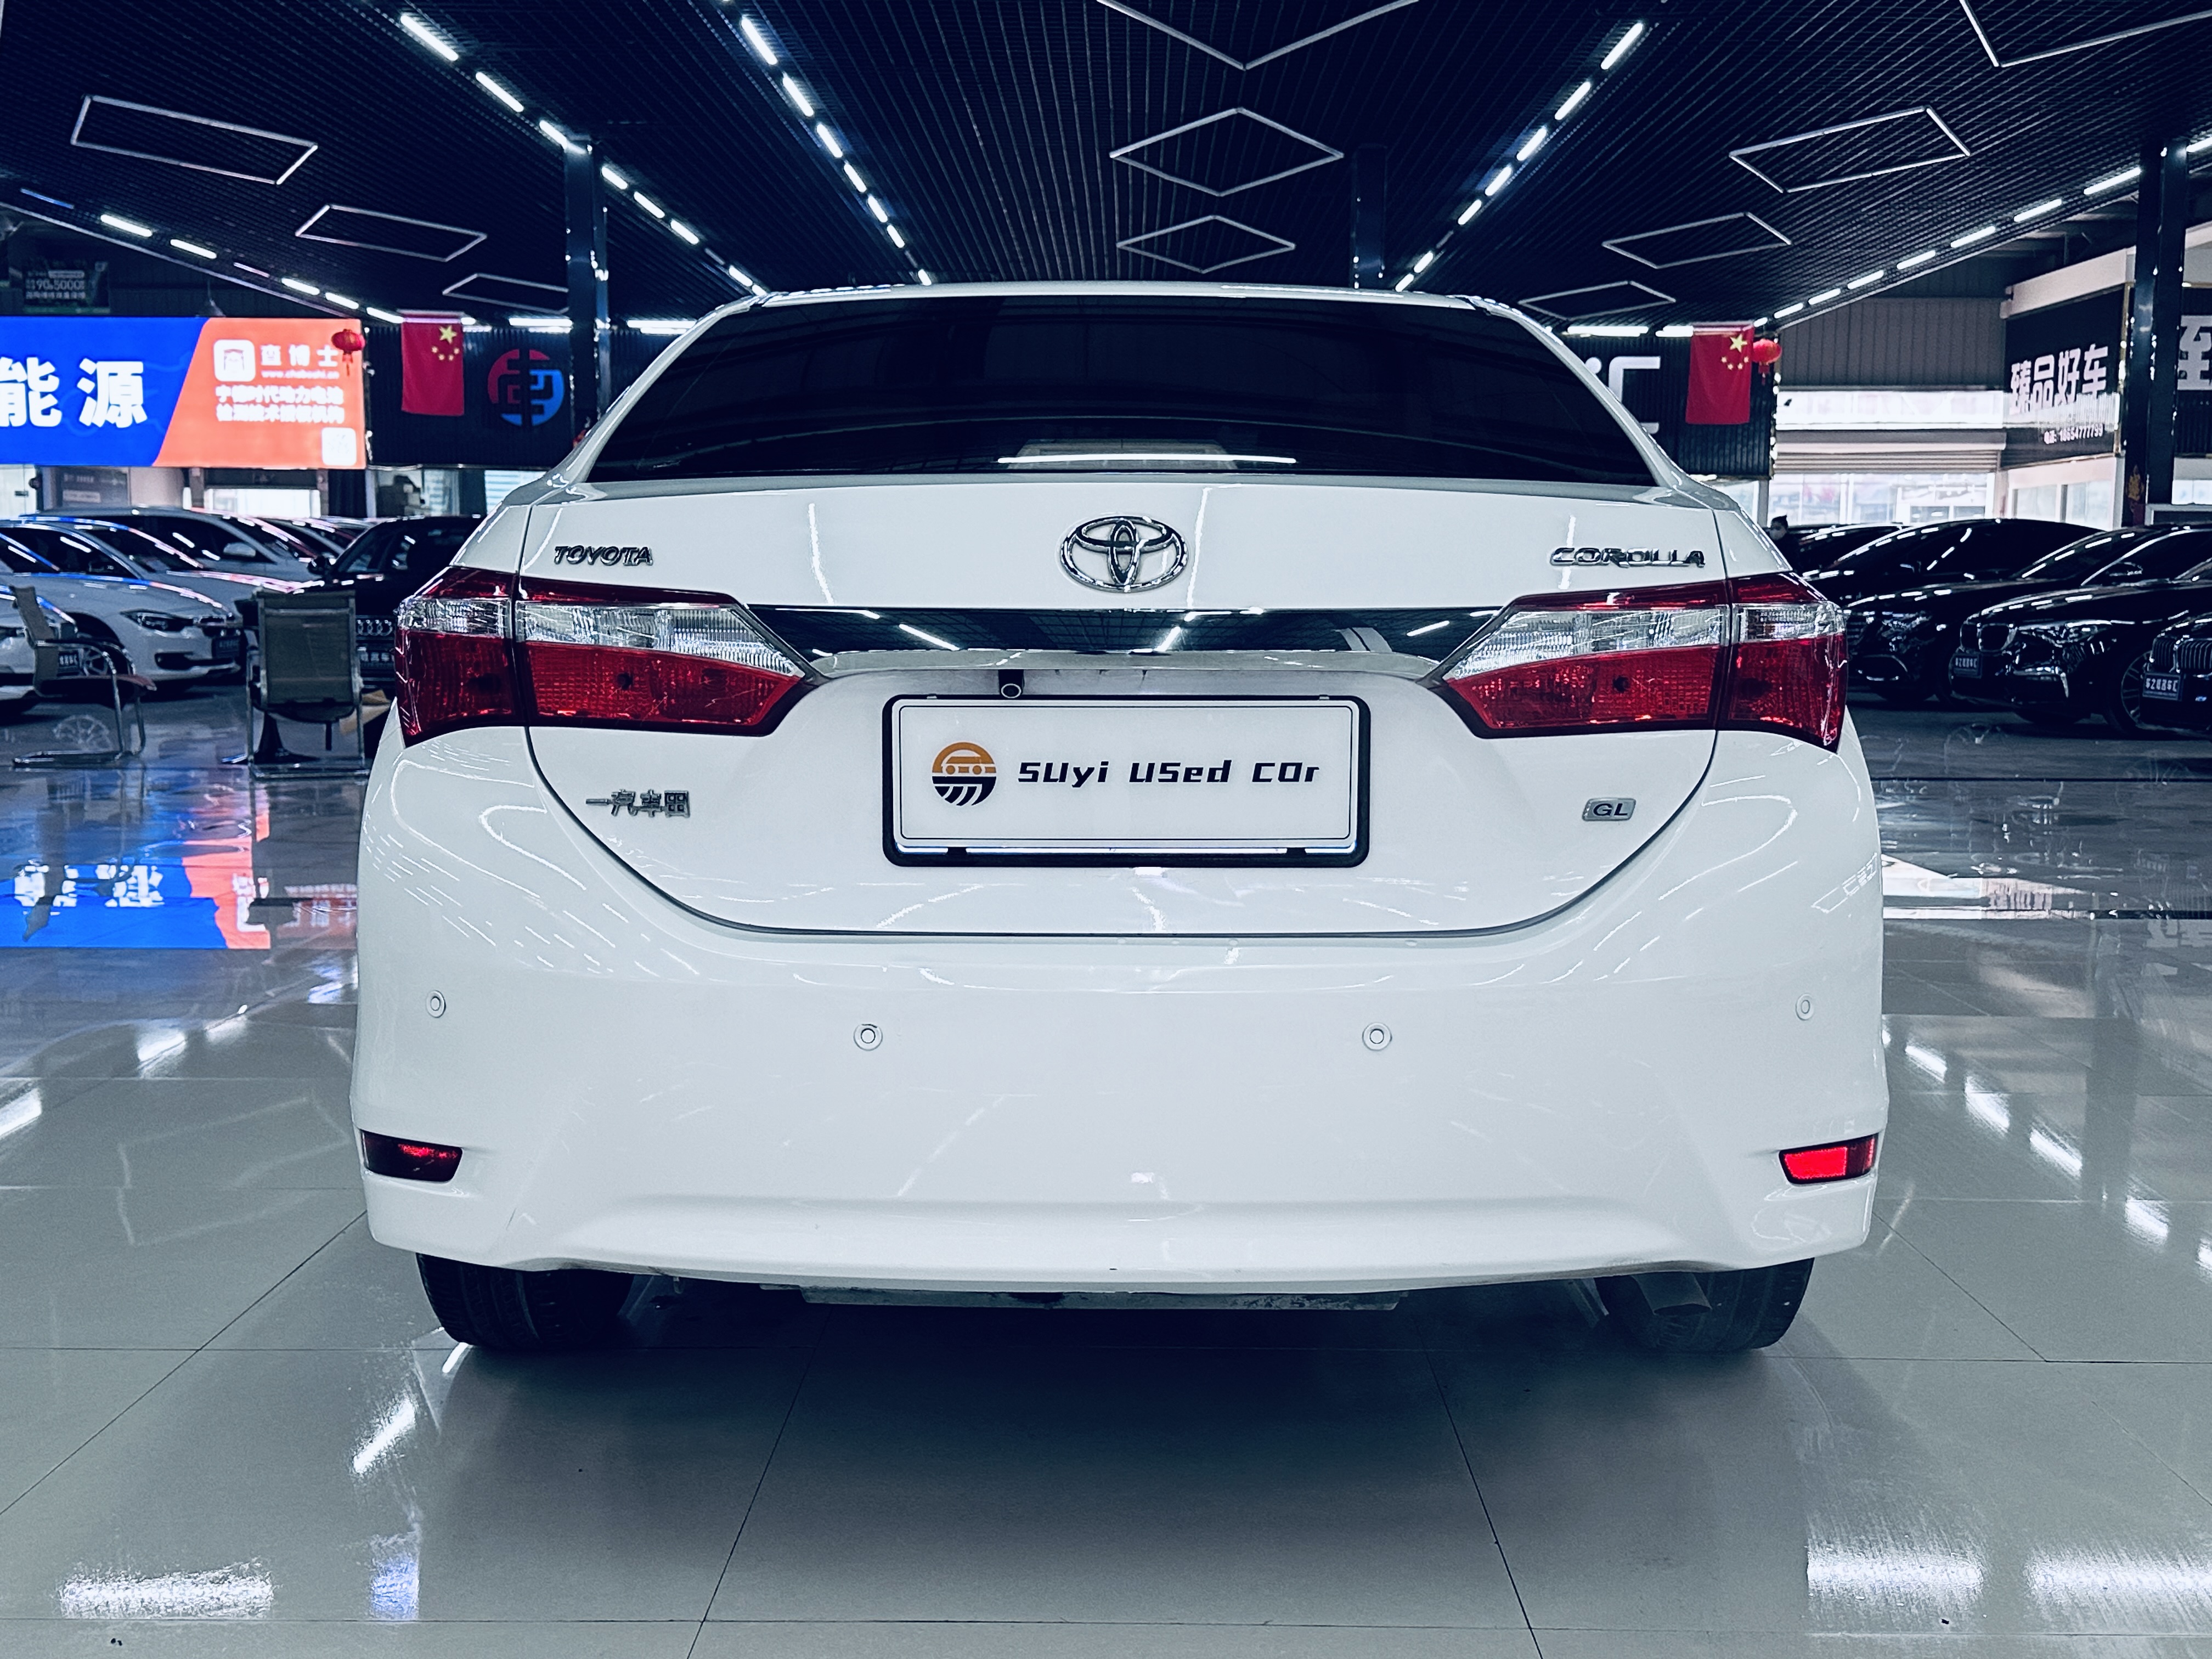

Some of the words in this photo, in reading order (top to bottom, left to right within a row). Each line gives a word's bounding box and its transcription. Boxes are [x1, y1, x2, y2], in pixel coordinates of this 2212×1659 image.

[2009, 343, 2108, 415] 臻品好车
[0, 357, 148, 428] 能源
[554, 545, 653, 566] TOYOTA
[1550, 548, 1705, 568] COROLLA
[1593, 803, 1628, 816] GL
